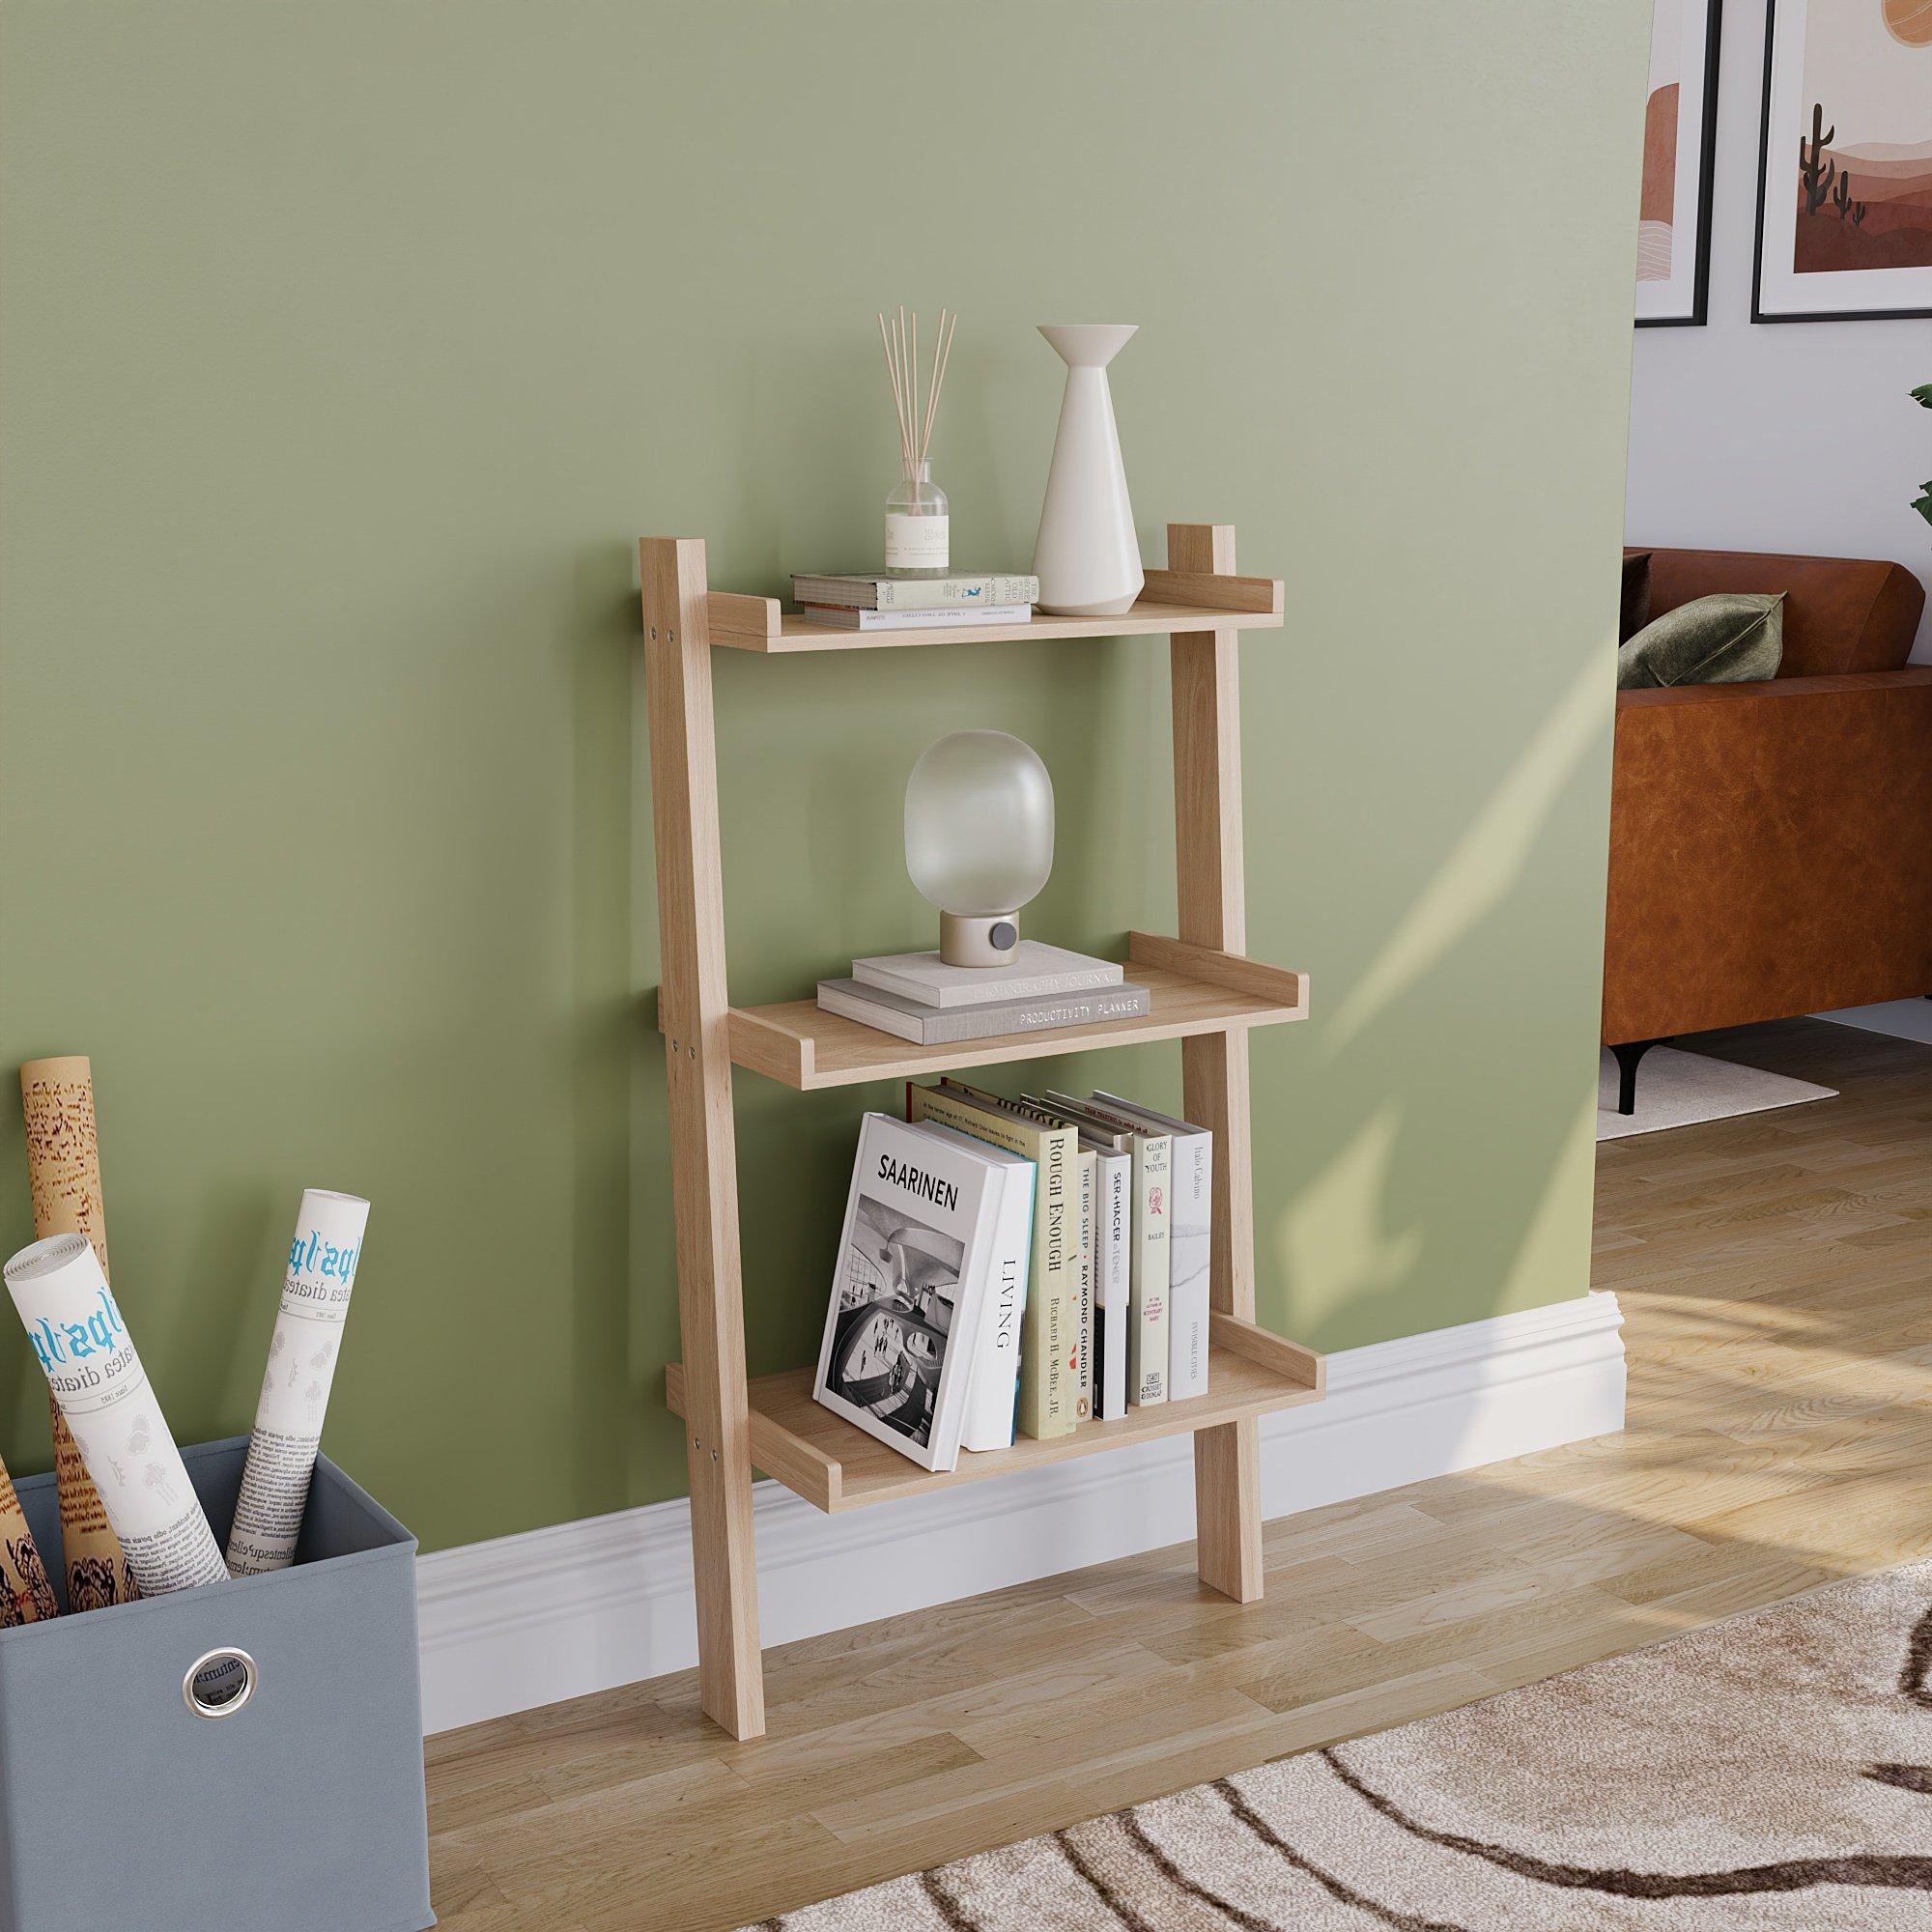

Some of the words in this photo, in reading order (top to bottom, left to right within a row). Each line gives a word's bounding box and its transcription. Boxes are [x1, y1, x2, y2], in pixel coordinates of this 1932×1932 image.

[974, 979, 1060, 999] PHOTOGRAPHY
[1064, 974, 1117, 989] JOURNAL
[1019, 1006, 1090, 1025] PRODUCTIVITY
[1097, 999, 1139, 1014] PLANNER
[1146, 1141, 1168, 1151] GLORY
[1152, 1152, 1161, 1162] OF
[1194, 1146, 1204, 1166] Italo
[1049, 1137, 1065, 1196] ROUGH
[1145, 1162, 1167, 1173] YOUTH
[877, 1154, 959, 1211] SAARINEN
[1193, 1167, 1204, 1200] Calvino
[1048, 1203, 1064, 1272] ENOUGH
[1148, 1232, 1165, 1240] BAILEY
[996, 1260, 1016, 1349] LIVING
[1080, 1264, 1089, 1323] RAYMOND
[1049, 1297, 1060, 1342] RICHARD
[1049, 1344, 1060, 1356] H.
[1080, 1330, 1089, 1388] CHANDLER
